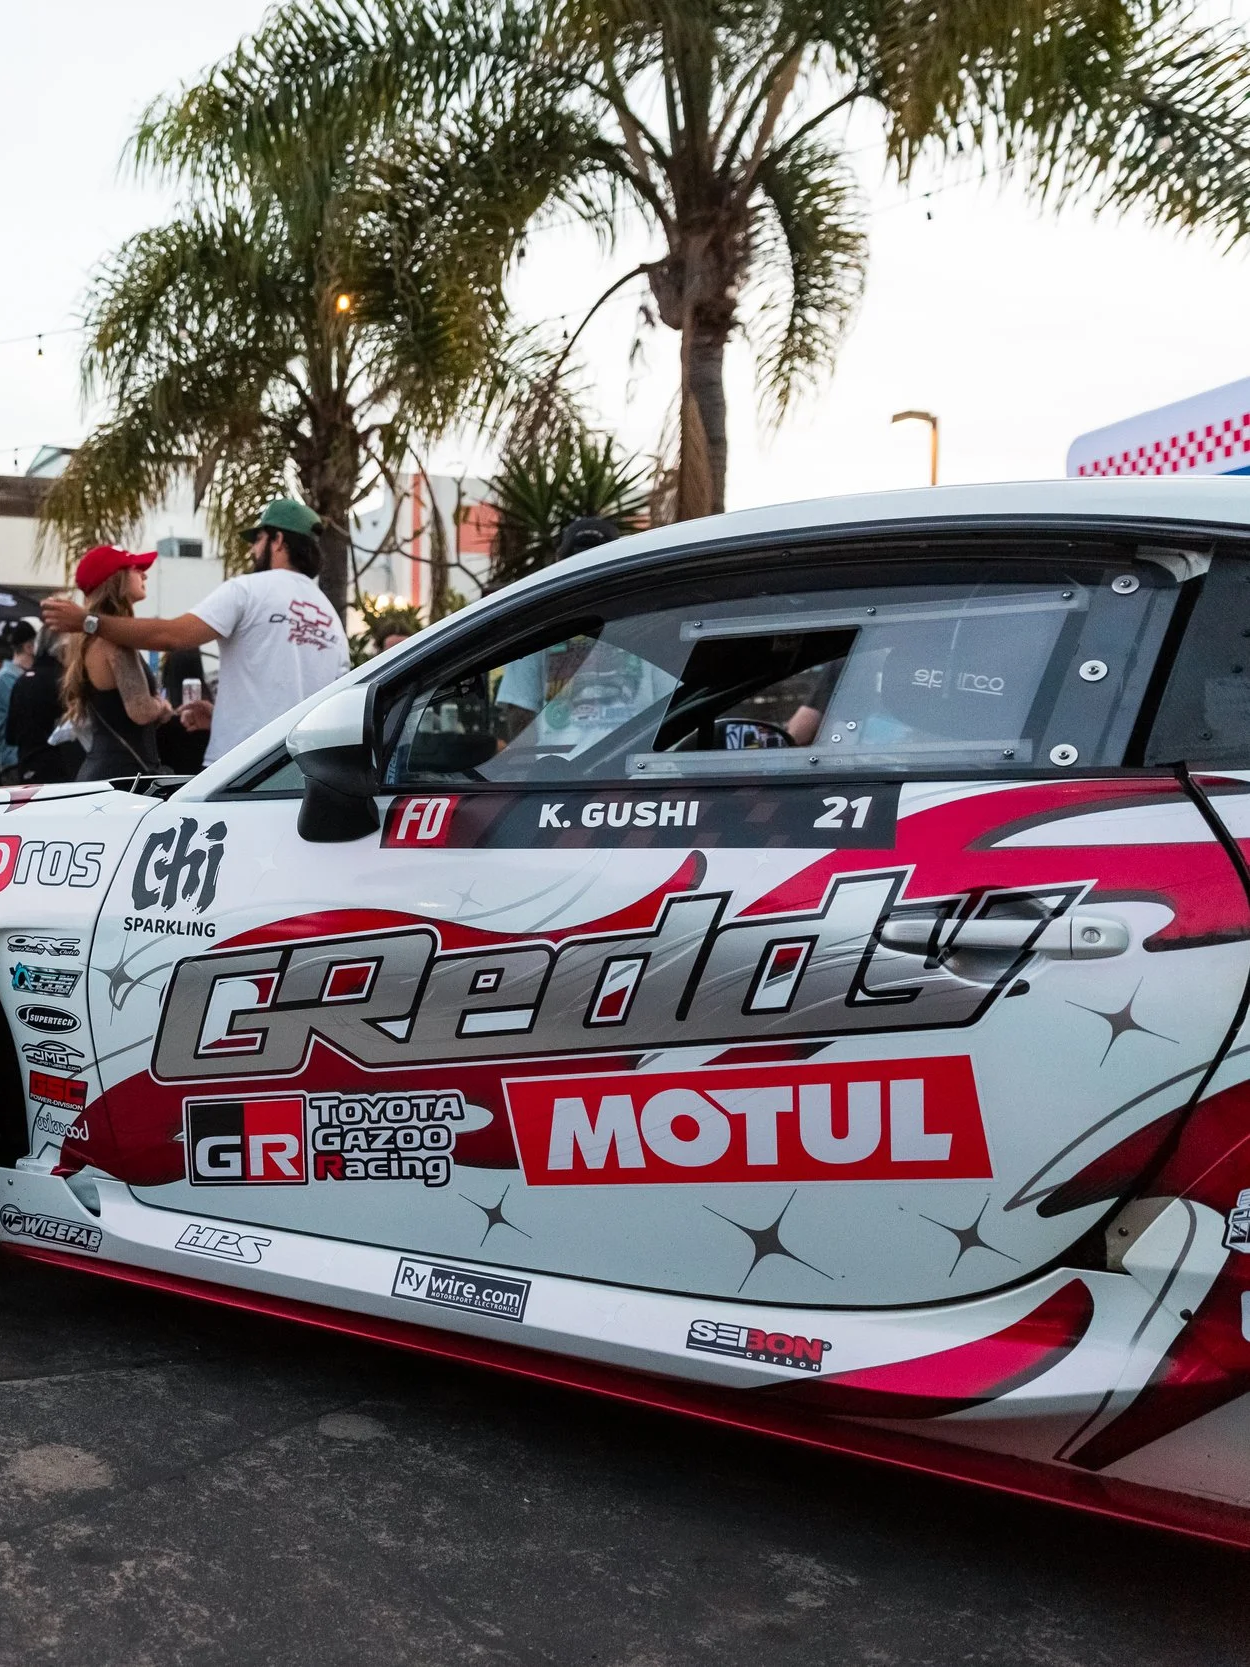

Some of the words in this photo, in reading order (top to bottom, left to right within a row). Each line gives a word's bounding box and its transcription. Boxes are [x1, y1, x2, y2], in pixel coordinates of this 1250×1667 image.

[913, 668, 1005, 692] sprco
[396, 797, 449, 840] FD
[538, 803, 571, 829] K.
[580, 800, 699, 828] GUSHI
[813, 796, 873, 829] 21
[123, 916, 217, 938] SPARKLING
[30, 1014, 74, 1027] SUPERTECH
[29, 1092, 84, 1111] POWER-DIVISION
[310, 1096, 462, 1124] TOYOTA
[314, 1126, 450, 1150] GAZOO
[547, 1078, 954, 1171] MOTUL
[195, 1133, 301, 1178] GR
[316, 1153, 449, 1185] Racing
[24, 1216, 102, 1247] WISEFAB
[175, 1223, 272, 1265] HPS
[431, 1291, 473, 1305] MOTORSPORT
[473, 1298, 519, 1314] ELECTRONICS
[745, 1351, 820, 1371] carbon
